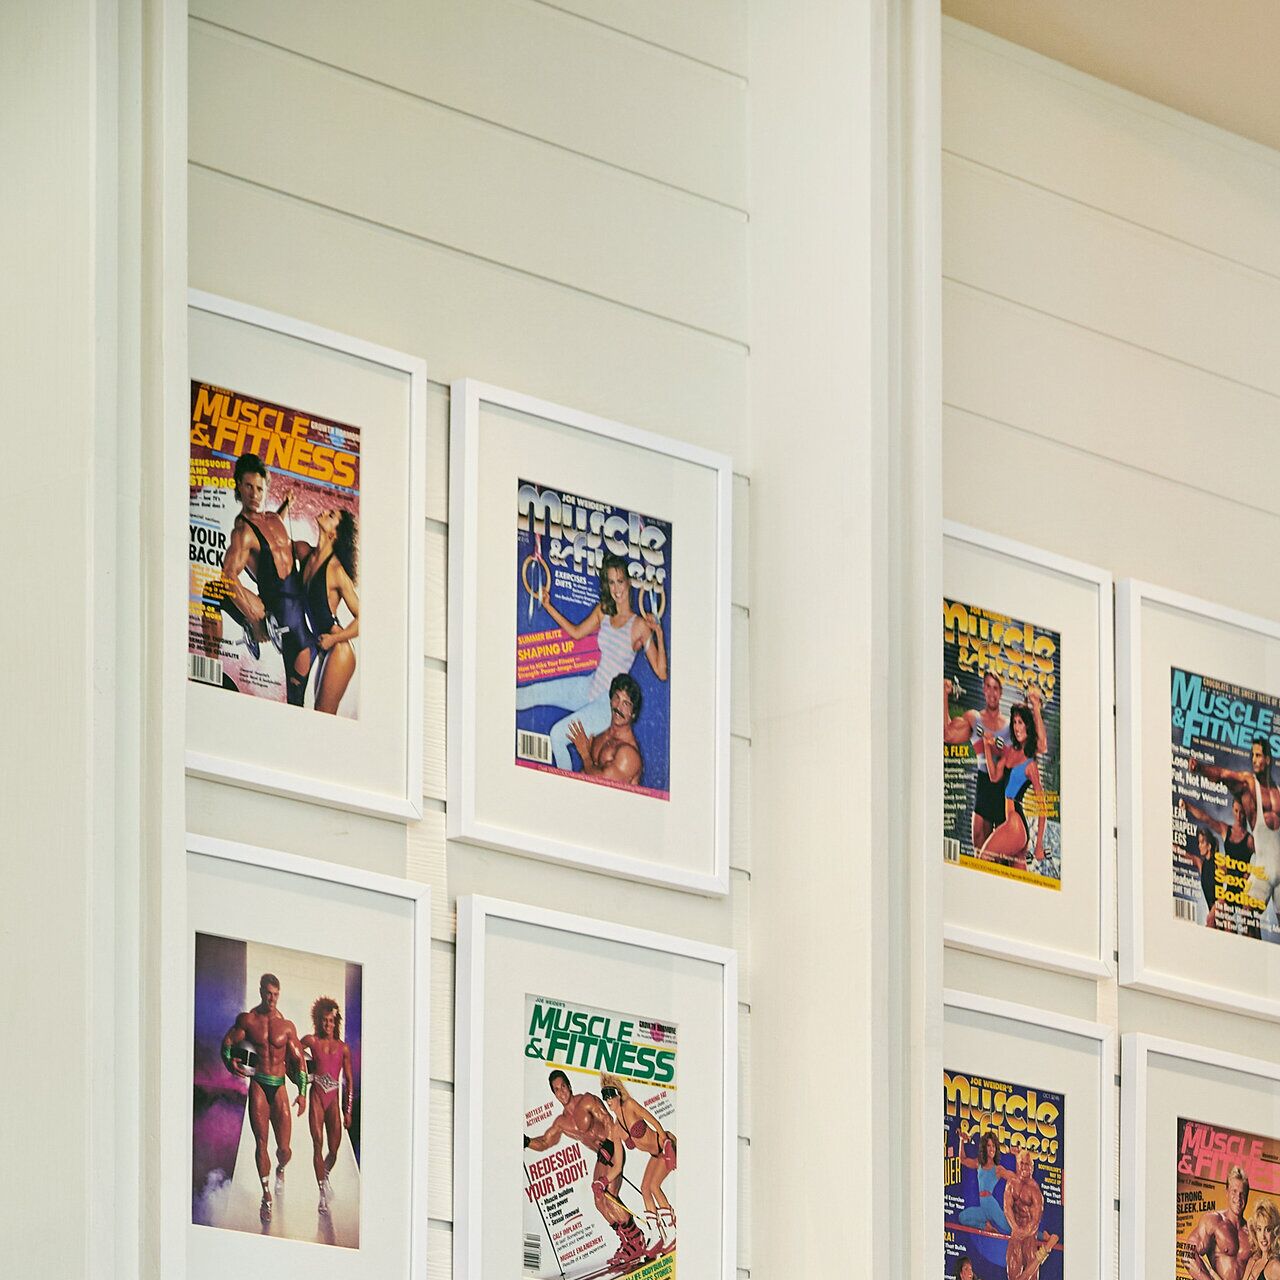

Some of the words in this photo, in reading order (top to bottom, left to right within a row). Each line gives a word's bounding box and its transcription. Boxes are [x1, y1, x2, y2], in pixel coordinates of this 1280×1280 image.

[193, 389, 311, 440] MUSCLE
[190, 423, 212, 448] &
[213, 417, 357, 487] FITNESS
[190, 459, 230, 469] SENSUOUS
[190, 476, 236, 489] STRONG
[562, 494, 576, 505] JOE
[577, 497, 612, 514] WEIDER'S
[190, 525, 226, 550] YOUR
[189, 544, 224, 571] BACK
[550, 539, 574, 567] &
[573, 532, 666, 593] fitess
[517, 643, 561, 661] SHAPING
[563, 641, 574, 652] UP
[1171, 670, 1273, 732] MUSCLE
[1172, 707, 1185, 728] &
[951, 745, 969, 757] FLEX
[1201, 775, 1228, 795] Muscle
[1215, 885, 1267, 910] Bodies
[529, 1004, 634, 1043] MUSCLE
[525, 1038, 545, 1060] &
[547, 1030, 675, 1082] FITNESS
[971, 1077, 982, 1086] JOE
[983, 1079, 1012, 1093] WEIDER'S
[526, 1111, 553, 1127] ACTIVEWEAR
[1181, 1125, 1264, 1160] MUSCLE
[529, 1143, 582, 1181] REDESIGN
[1178, 1154, 1193, 1175] &
[525, 1178, 555, 1203] YOUR
[556, 1160, 589, 1189] BODY!
[543, 1194, 558, 1205] Muscle
[1199, 1201, 1215, 1211] LEAN
[560, 1250, 576, 1262] MUSCLE
[642, 1255, 673, 1278] BODYBUILDING
